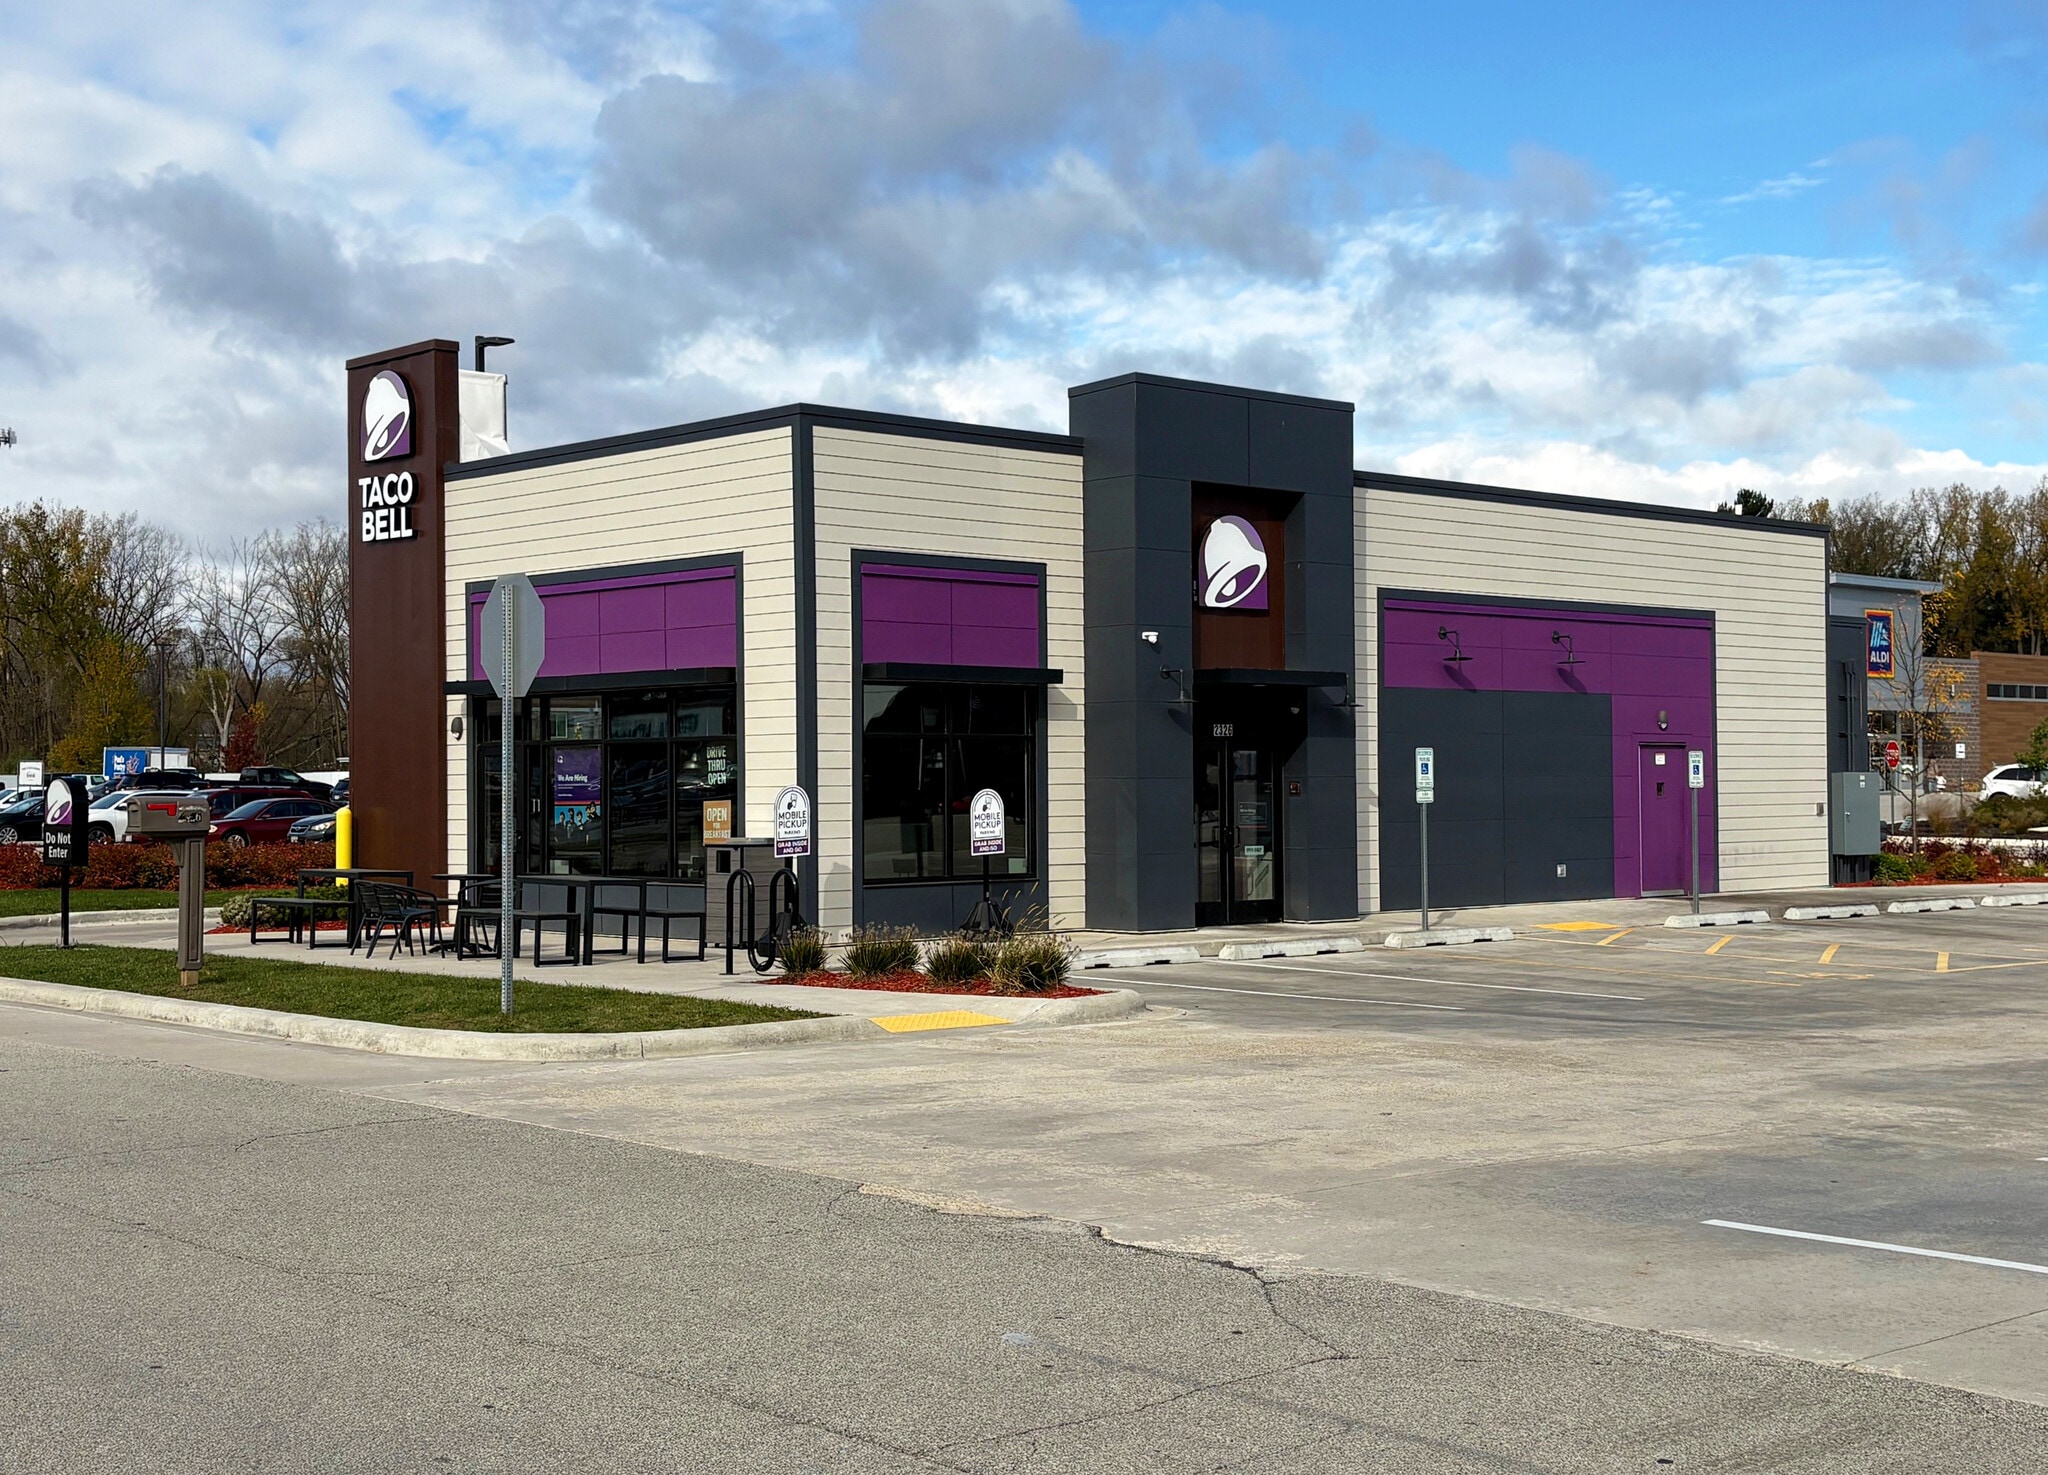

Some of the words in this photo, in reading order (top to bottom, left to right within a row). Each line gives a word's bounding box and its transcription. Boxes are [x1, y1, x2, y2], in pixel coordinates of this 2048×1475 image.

[358, 471, 414, 508] TACO
[362, 507, 413, 543] BELL
[1870, 651, 1890, 663] ALDI
[1213, 724, 1233, 736] 2326
[706, 745, 727, 759] DRIVE
[707, 759, 726, 772] THRU
[565, 774, 574, 782] Are
[574, 773, 588, 783] Hiring
[707, 772, 727, 785] OPEN
[706, 807, 727, 821] OPEN
[778, 810, 807, 820] MOBILE
[974, 812, 1001, 821] MOBILE
[778, 819, 807, 829] PICKUP
[974, 820, 1001, 829] PICKUP
[45, 832, 56, 844] Do
[57, 832, 71, 844] Not
[48, 846, 68, 858] Enter
